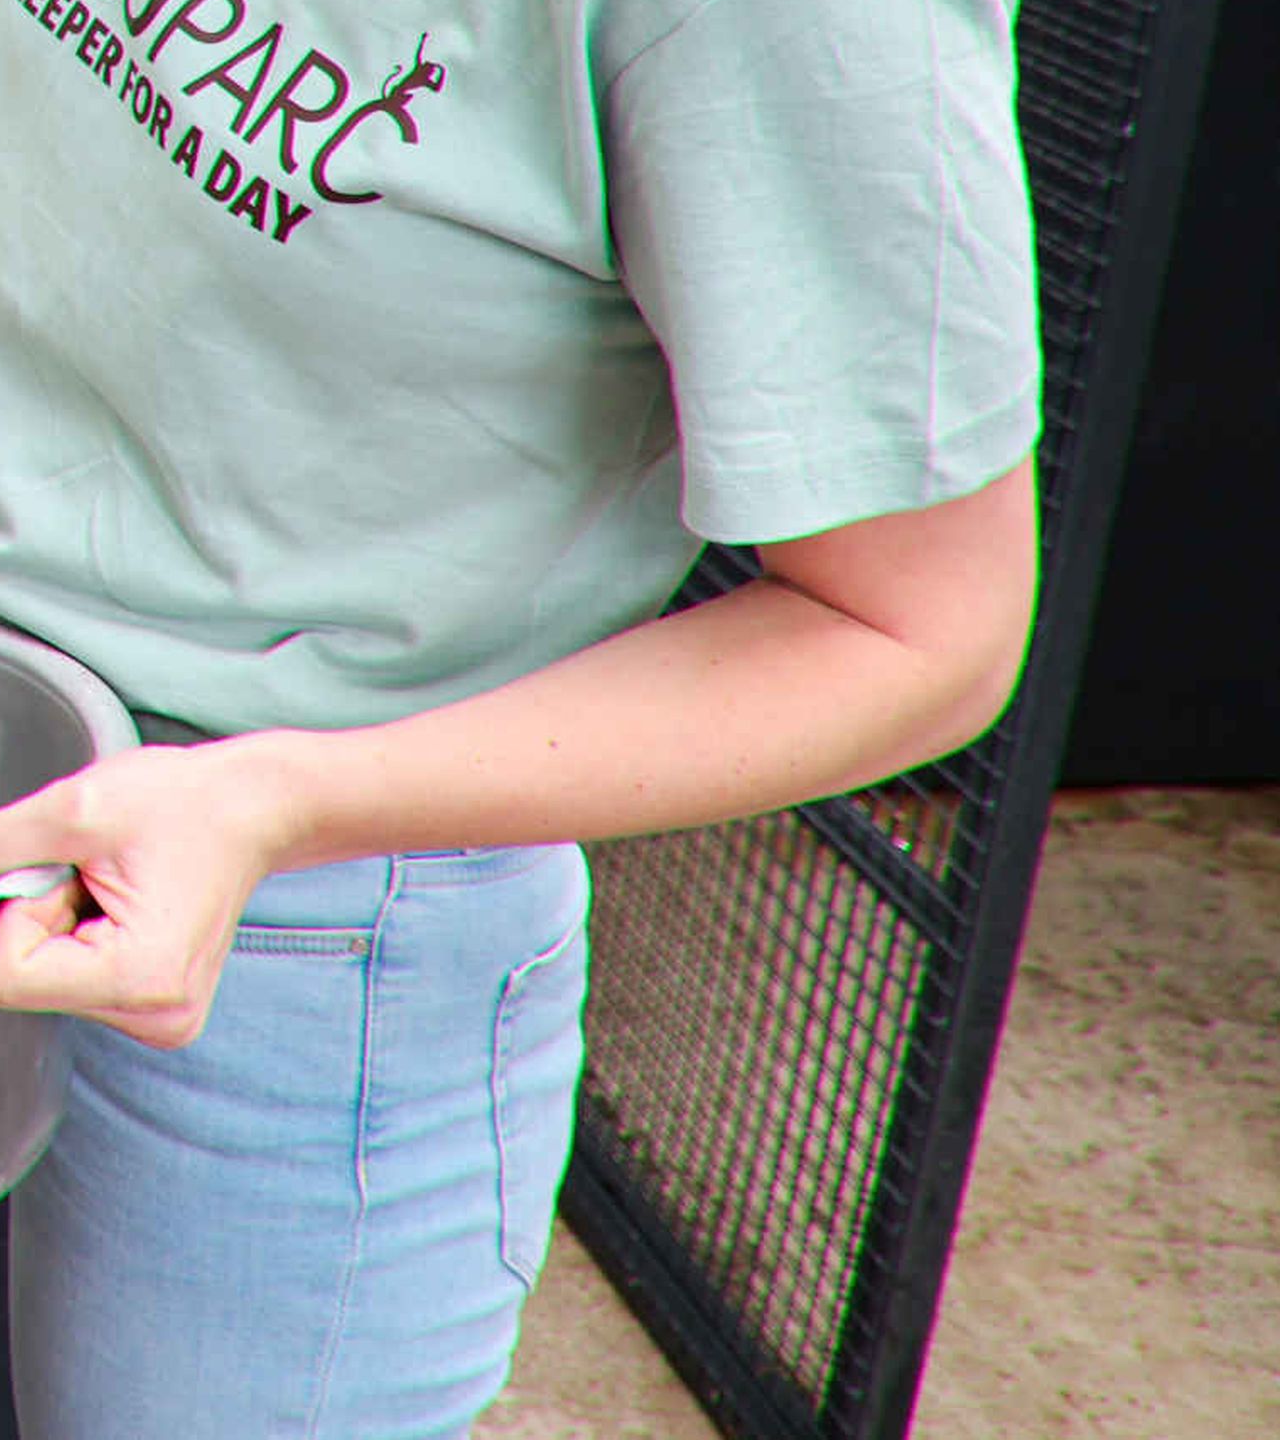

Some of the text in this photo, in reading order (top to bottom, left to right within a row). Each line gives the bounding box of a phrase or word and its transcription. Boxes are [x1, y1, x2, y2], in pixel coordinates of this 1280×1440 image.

[119, 59, 173, 149] FOR
[171, 126, 204, 178] A
[203, 149, 313, 244] DAY
